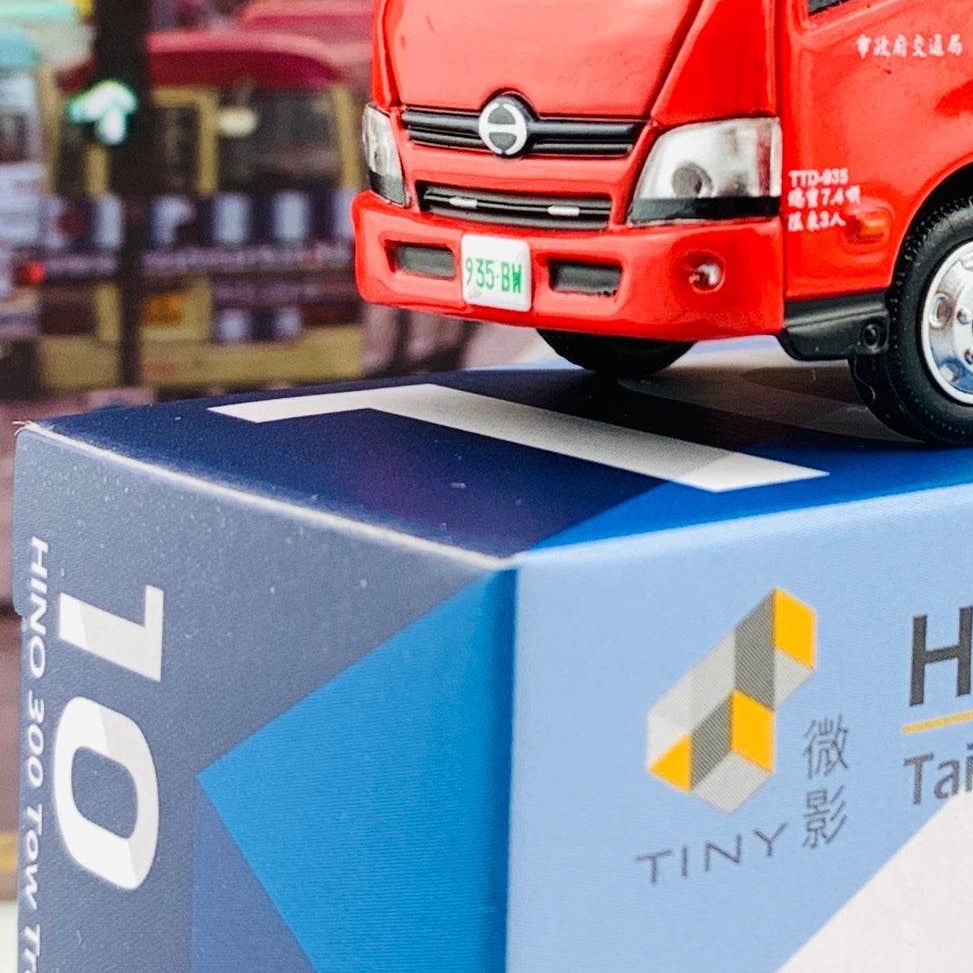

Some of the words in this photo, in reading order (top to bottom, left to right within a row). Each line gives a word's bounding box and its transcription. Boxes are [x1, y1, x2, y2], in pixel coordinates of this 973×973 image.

[855, 33, 963, 59] 市政府交通局
[27, 536, 49, 680] HINO
[27, 690, 45, 788] 300
[53, 584, 165, 890] 10
[803, 714, 848, 850] 微影
[22, 804, 42, 911] Tow
[635, 822, 788, 884] TINY
